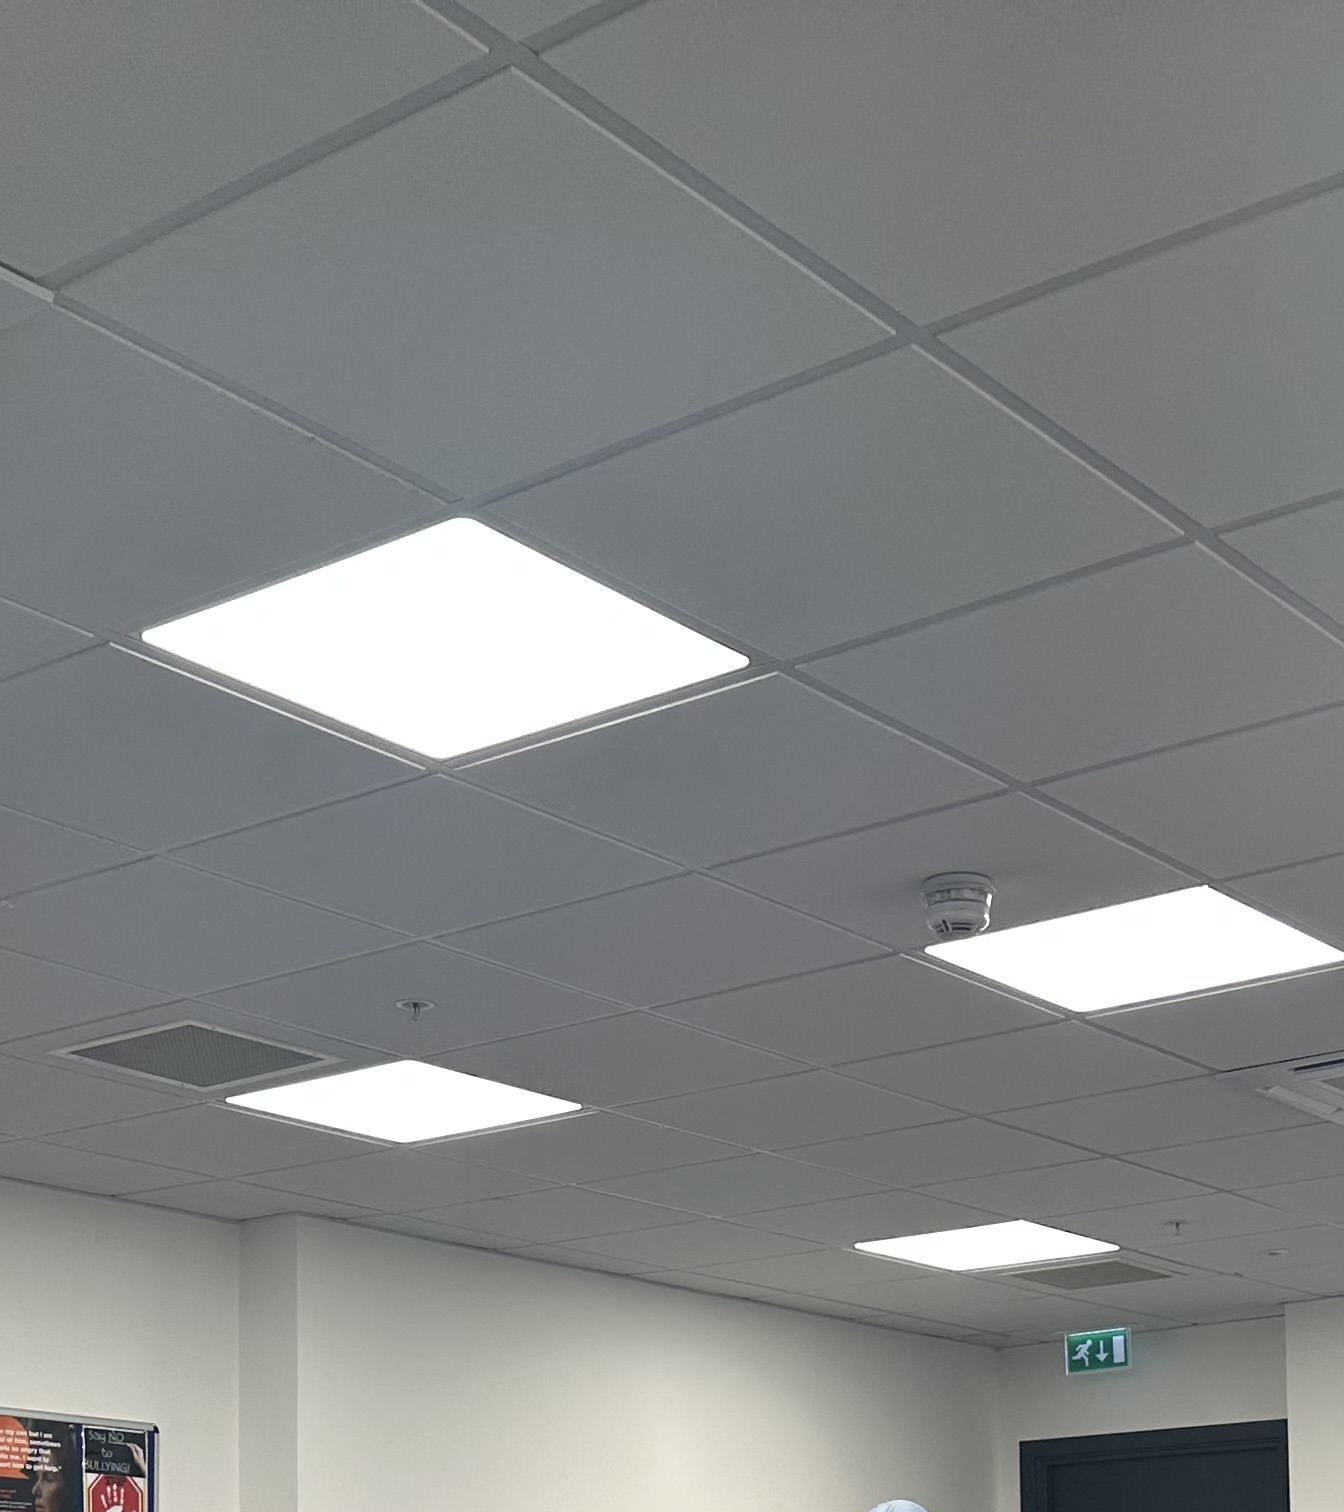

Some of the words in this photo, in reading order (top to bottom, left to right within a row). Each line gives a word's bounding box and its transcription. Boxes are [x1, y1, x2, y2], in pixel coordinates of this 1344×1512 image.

[89, 1430, 106, 1443] Say
[108, 1432, 125, 1442] NO
[30, 1440, 61, 1448] sometimes
[101, 1448, 113, 1458] to
[85, 1460, 131, 1473] BULLYING!
